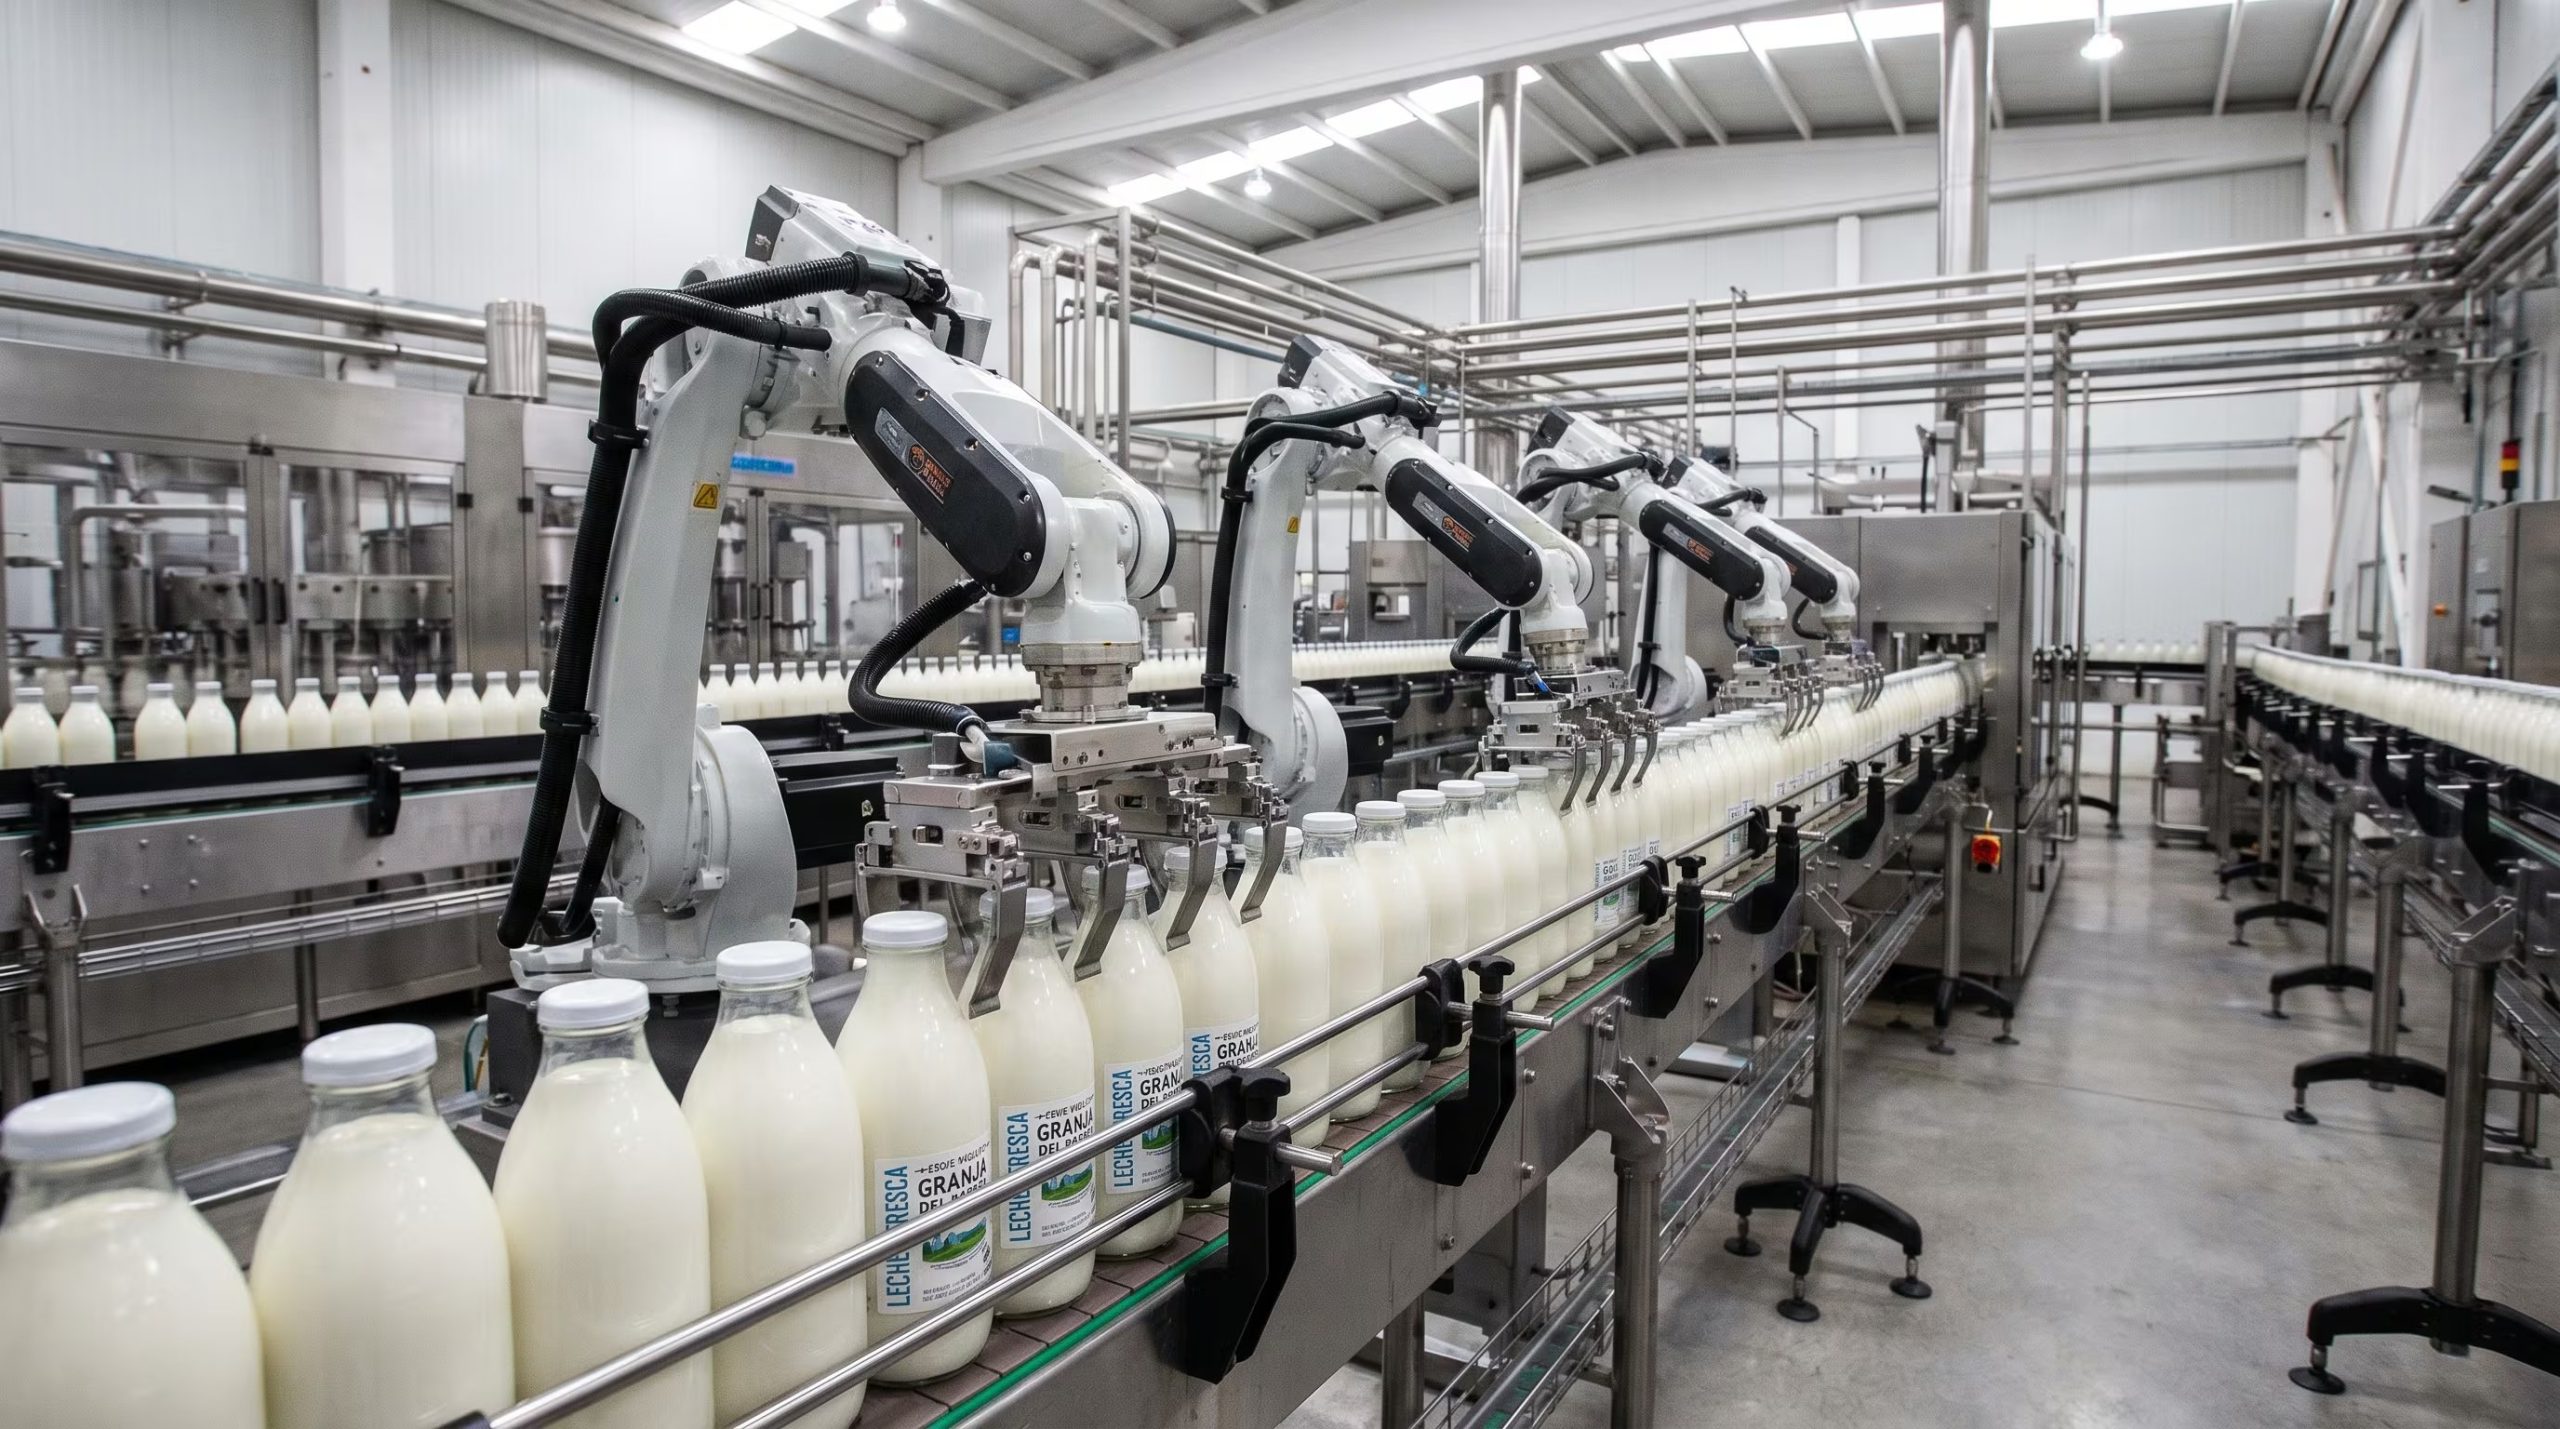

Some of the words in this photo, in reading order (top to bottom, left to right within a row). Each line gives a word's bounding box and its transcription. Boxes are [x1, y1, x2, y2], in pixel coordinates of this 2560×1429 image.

[1191, 1033, 1211, 1077] ESCA
[1111, 1069, 1133, 1123] RESCA
[1006, 1112, 1030, 1173] RESCA
[1037, 1107, 1094, 1142] GRANJA
[918, 1156, 987, 1198] GRANJA
